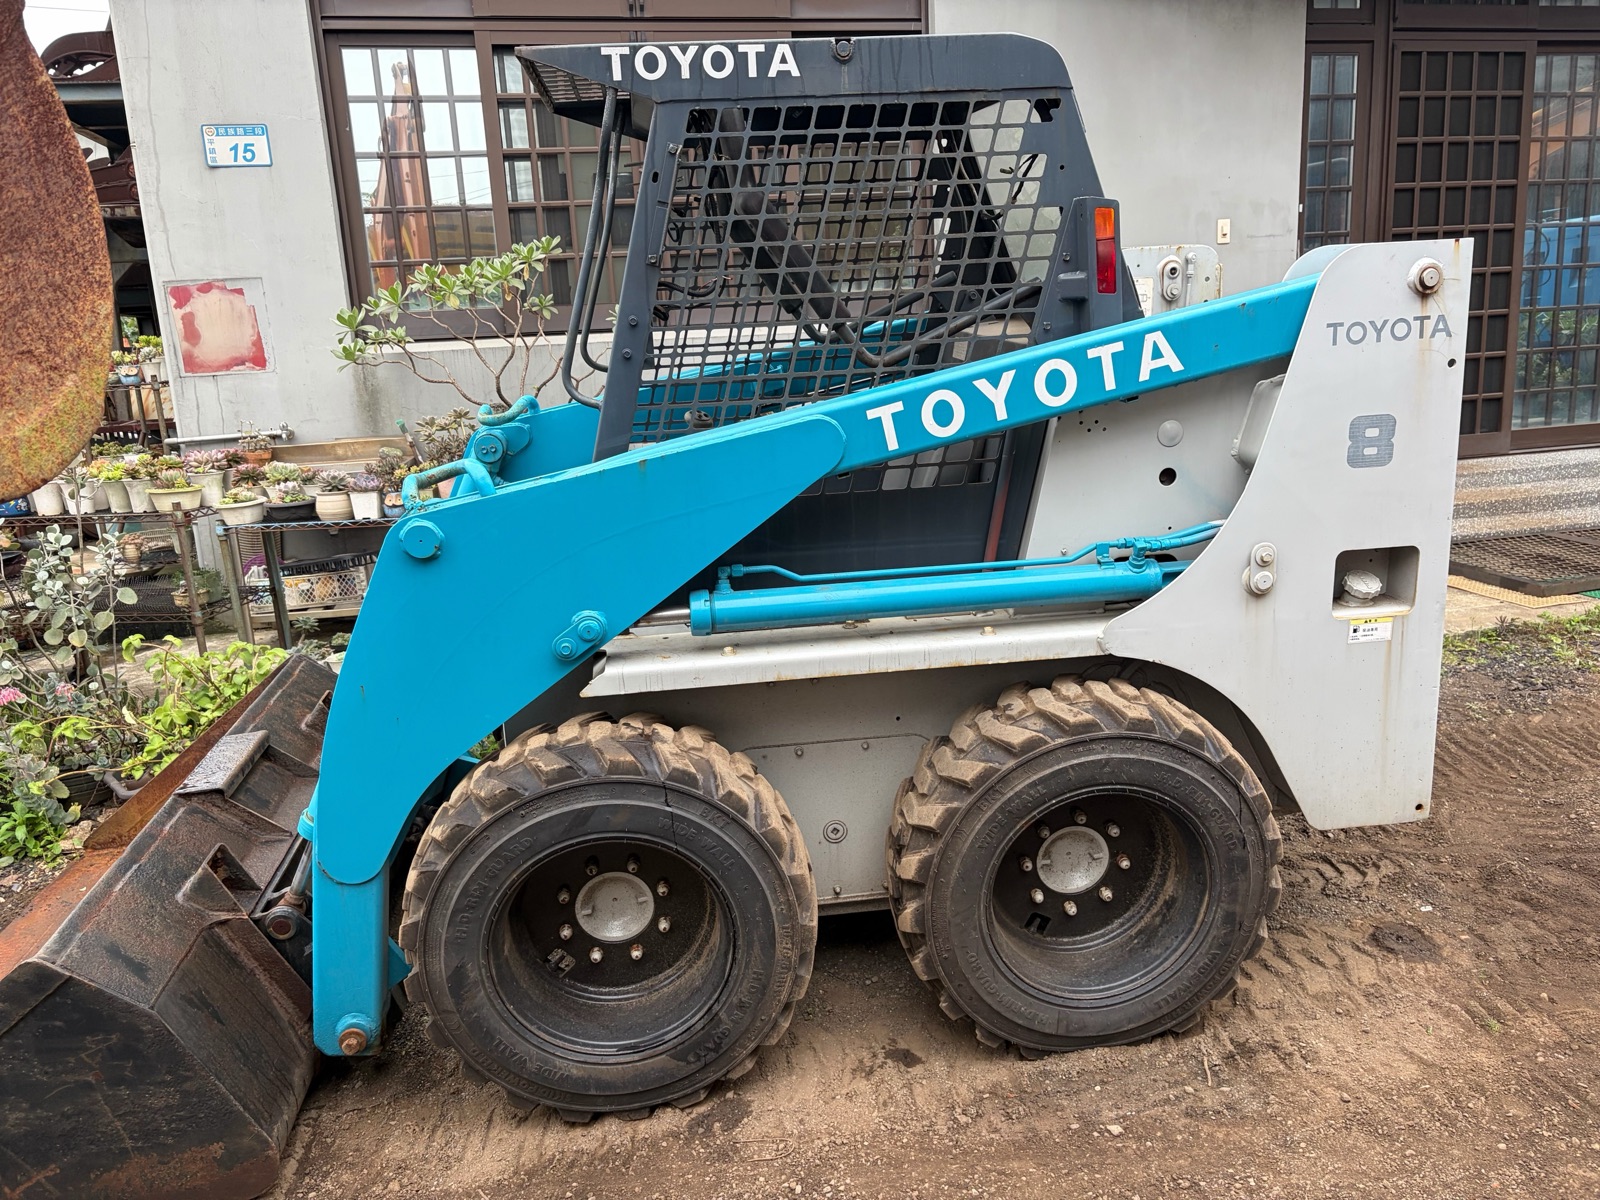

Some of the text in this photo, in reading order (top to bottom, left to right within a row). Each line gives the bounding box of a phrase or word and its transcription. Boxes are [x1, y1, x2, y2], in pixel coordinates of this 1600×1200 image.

[600, 43, 801, 82] TOYOTA
[229, 142, 256, 163] 15
[1326, 314, 1452, 346] TOYOTA
[866, 330, 1185, 452] TOYOTA
[1346, 413, 1397, 469] 8
[699, 806, 730, 828] BKT
[486, 837, 534, 878] GUARD
